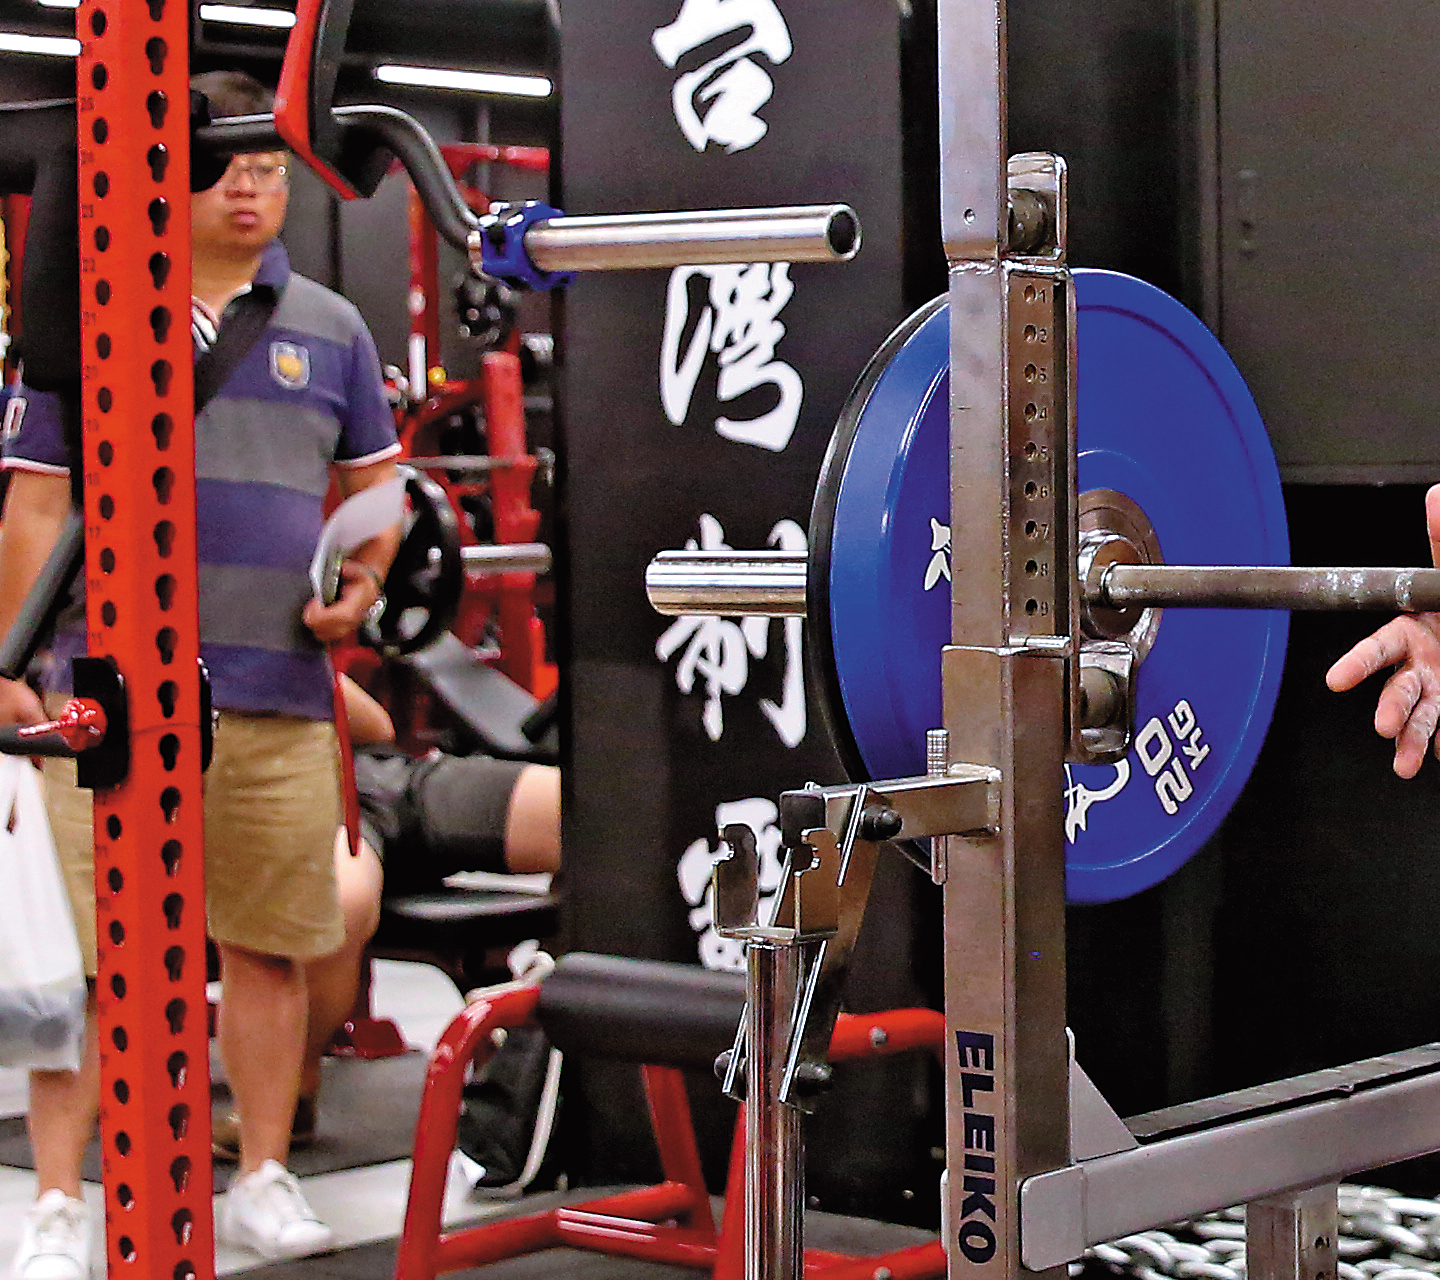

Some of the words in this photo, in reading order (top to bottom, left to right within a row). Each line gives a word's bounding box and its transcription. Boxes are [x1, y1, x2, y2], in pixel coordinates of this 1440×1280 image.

[1134, 716, 1194, 815] 20
[1167, 699, 1211, 770] KG
[955, 1030, 997, 1264] ELEIKO
